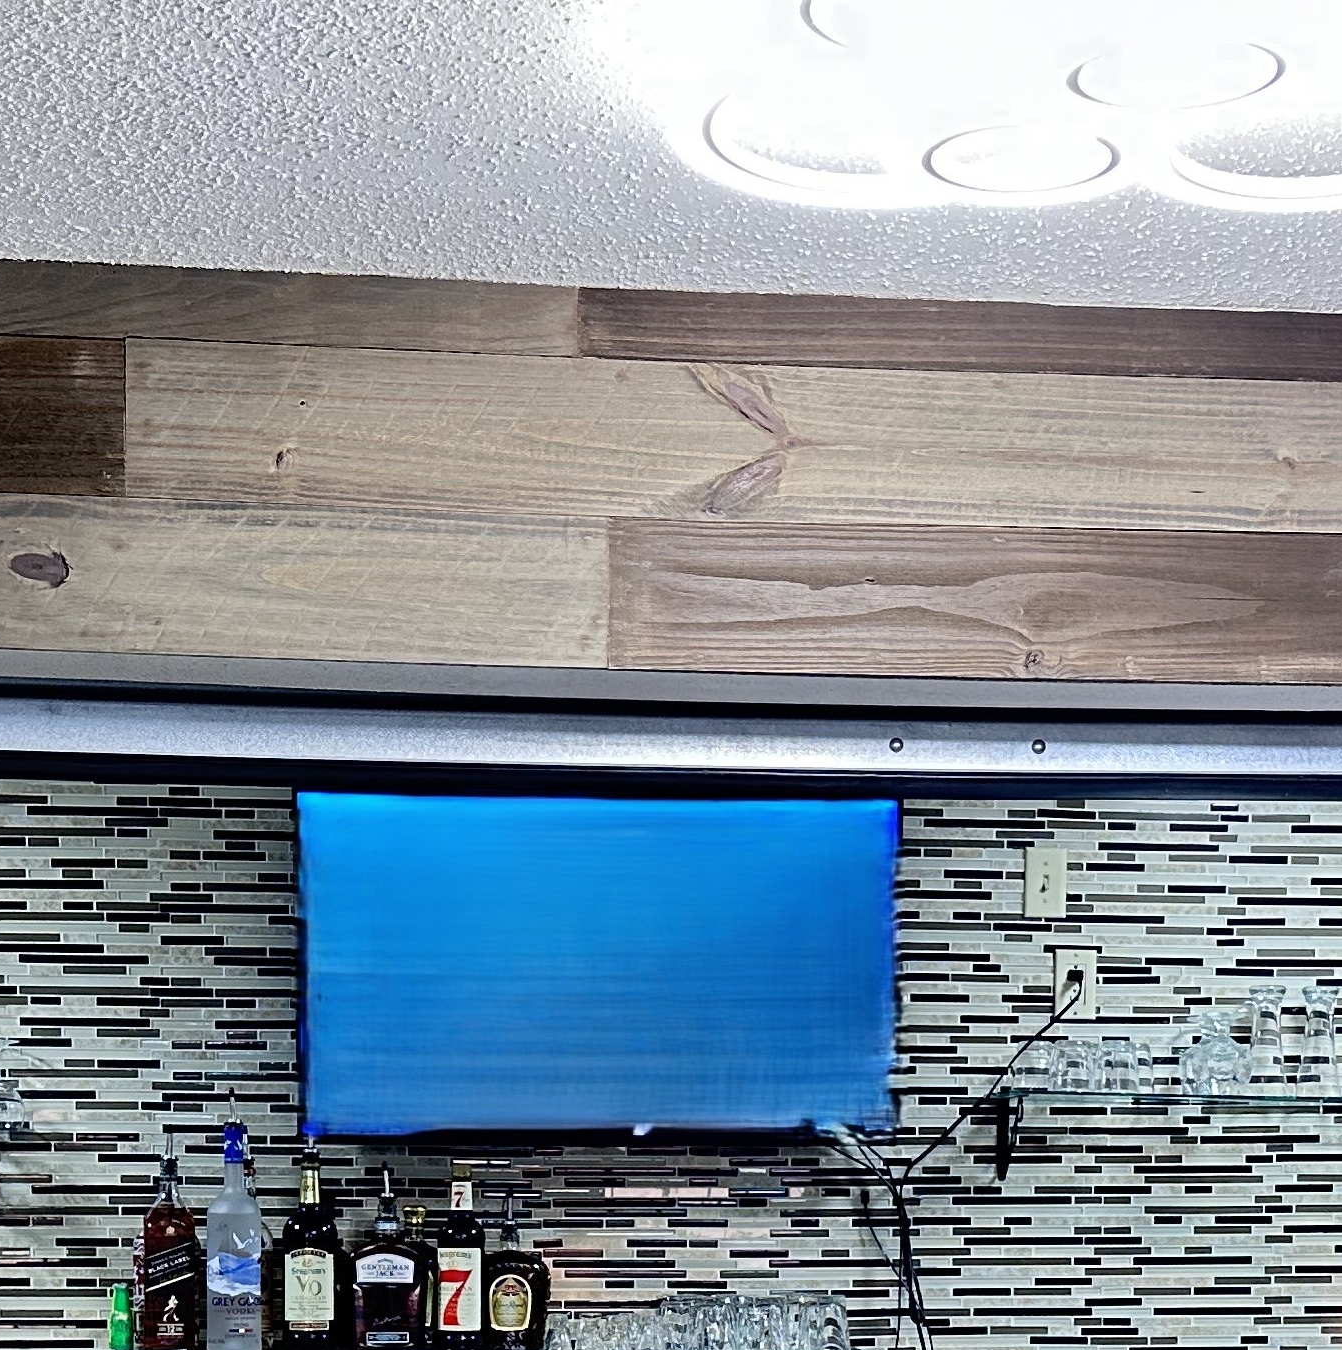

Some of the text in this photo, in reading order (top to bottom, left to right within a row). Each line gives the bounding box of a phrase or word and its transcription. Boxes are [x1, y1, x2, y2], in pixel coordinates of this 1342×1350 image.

[454, 1191, 465, 1208] 7
[148, 1263, 169, 1274] BLACK
[169, 1256, 190, 1267] LABEL
[212, 1296, 235, 1306] GREY
[439, 1268, 474, 1326] 7
